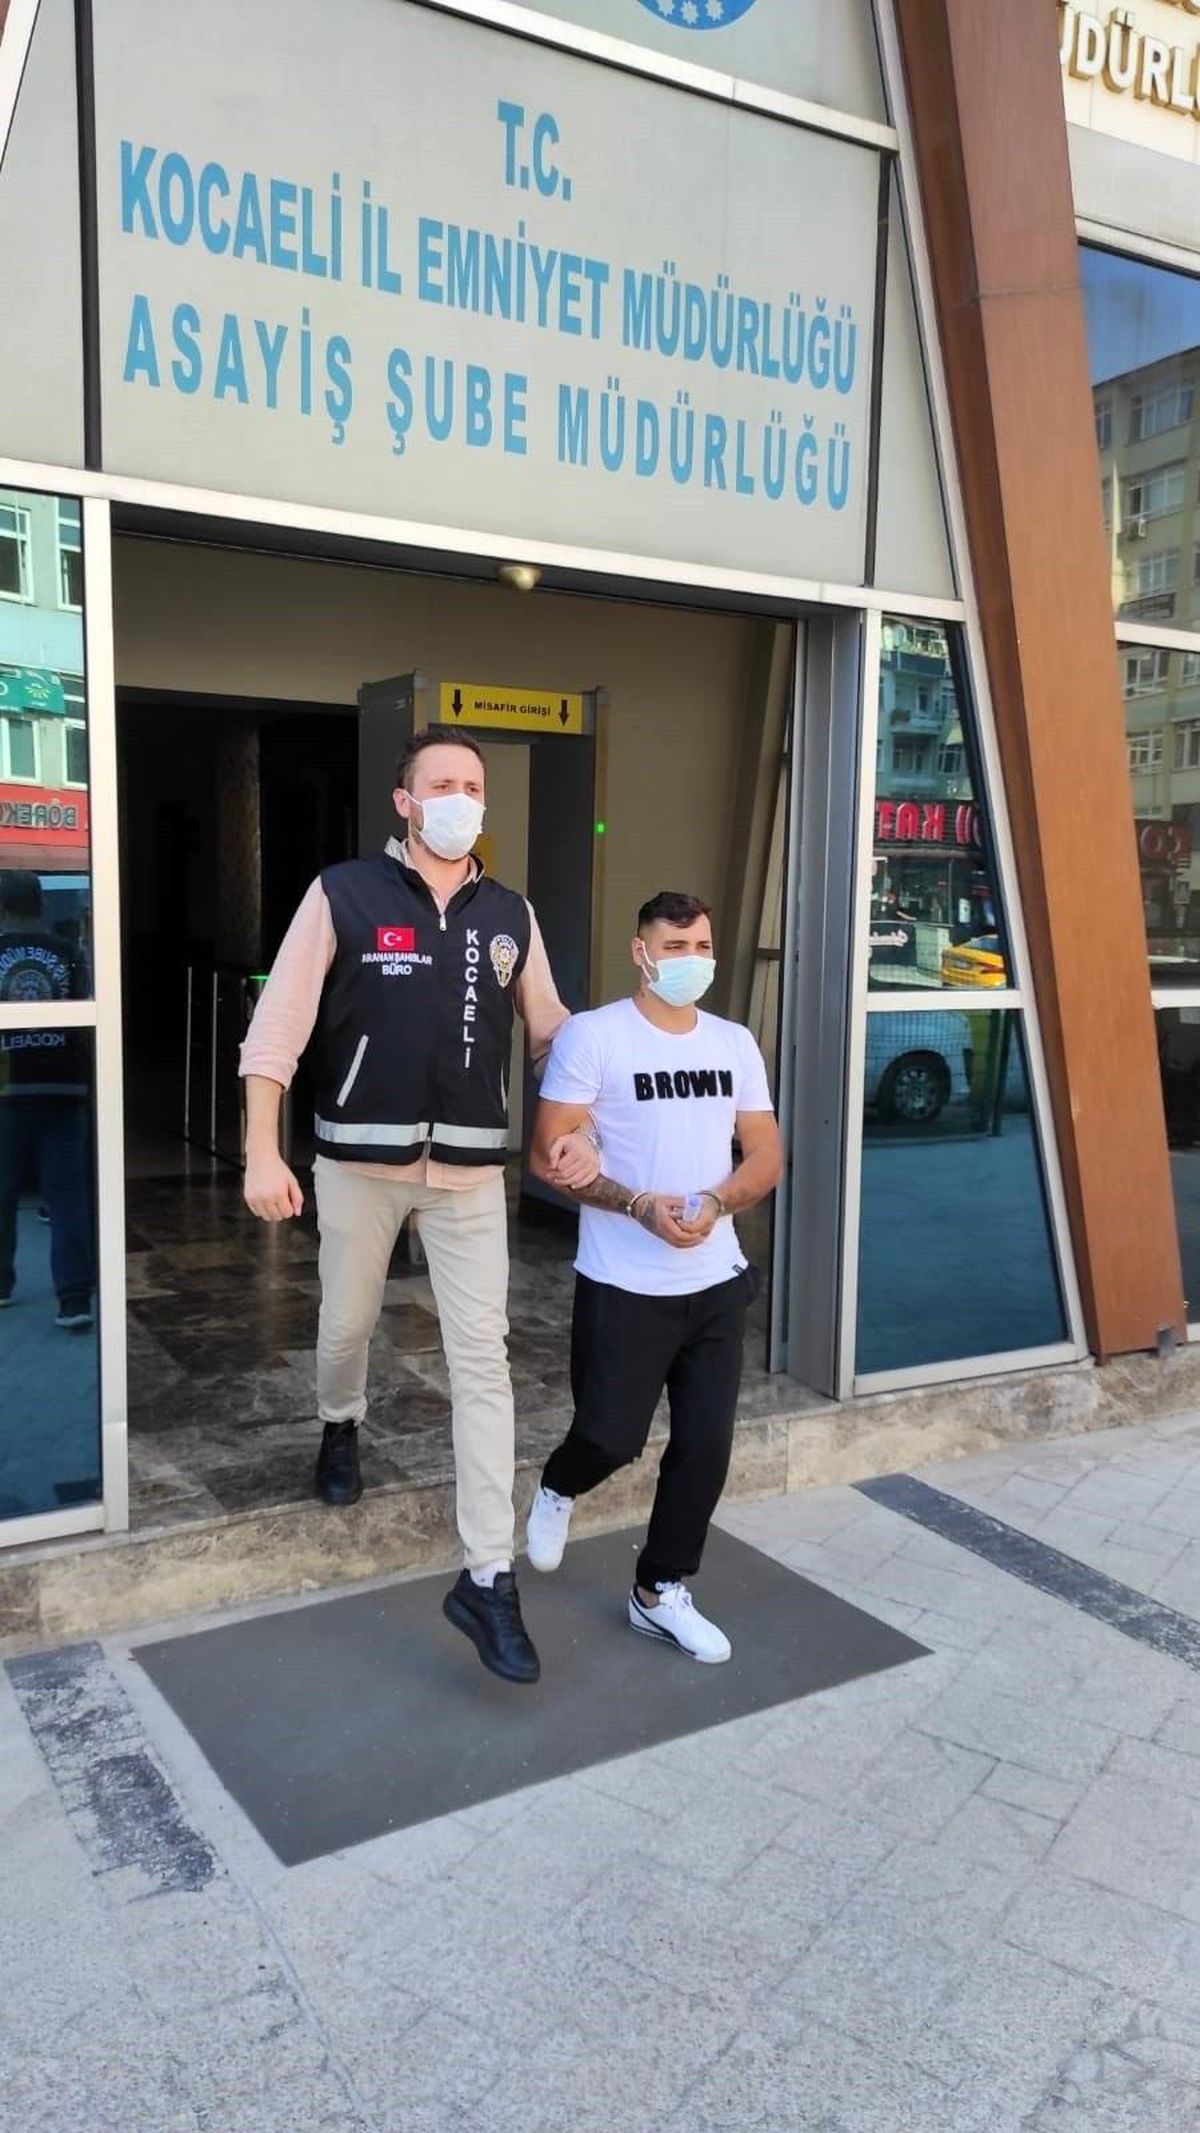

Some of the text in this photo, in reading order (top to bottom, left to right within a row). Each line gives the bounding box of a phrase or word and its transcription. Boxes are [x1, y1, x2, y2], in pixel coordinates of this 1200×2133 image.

[1058, 3, 1200, 121] DÜRL
[497, 100, 572, 200] T.C.
[120, 140, 857, 395] KOCAELİ İL EMNİYET MÜDÜRLÜĞÜ
[123, 295, 851, 512] ASAYİŞ ŞUBE MÜDÜRLÜĞÜ
[474, 700, 517, 714] MİSAFİR
[381, 962, 413, 976] BÜRO
[463, 928, 480, 1069] KOCAELİ
[633, 1069, 733, 1102] BROWN
